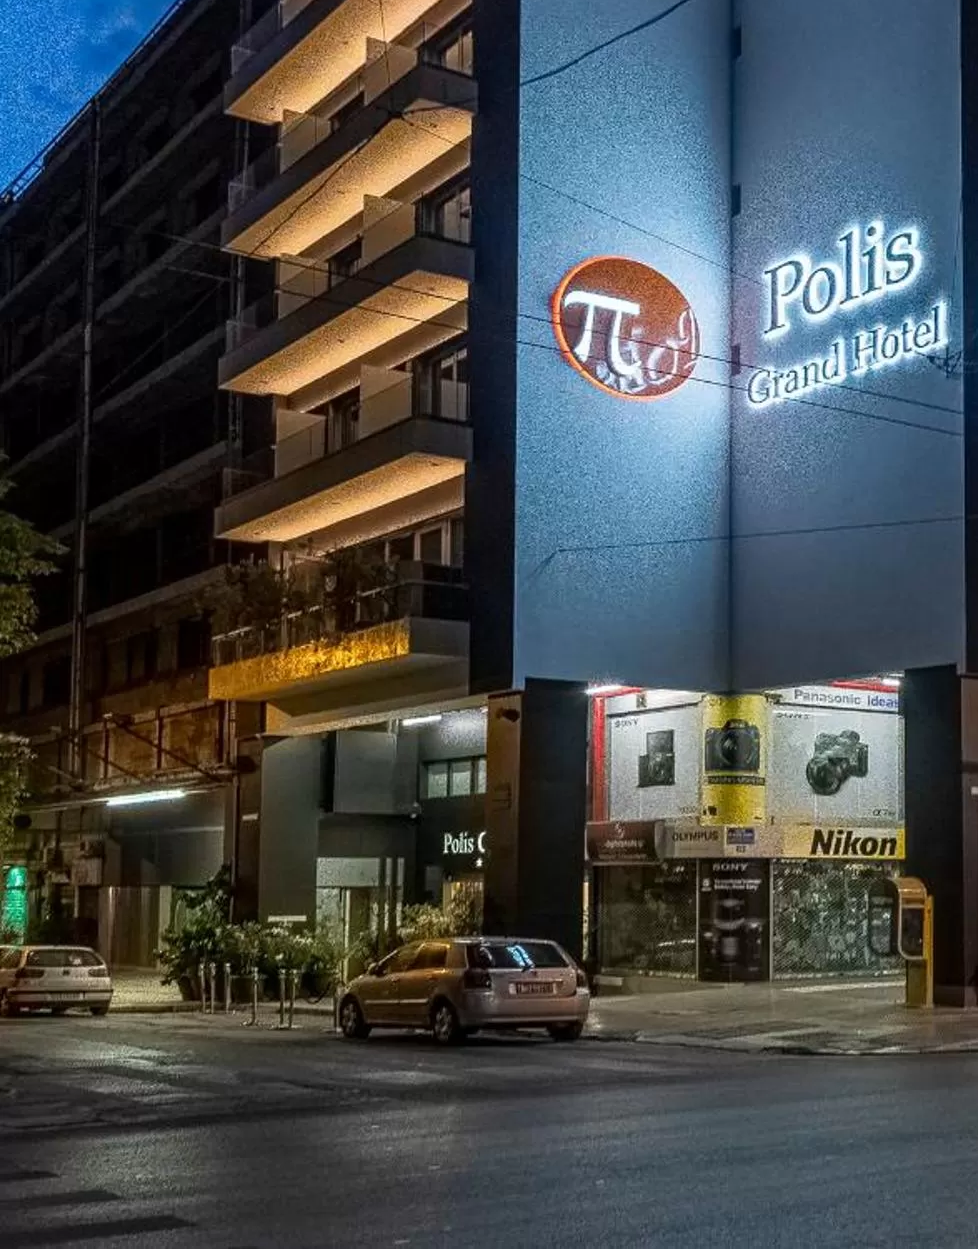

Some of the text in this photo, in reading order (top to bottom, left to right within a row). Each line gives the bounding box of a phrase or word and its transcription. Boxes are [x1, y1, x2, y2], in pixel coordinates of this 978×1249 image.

[763, 225, 919, 335] Polis
[748, 305, 945, 405] Grand Hotel
[794, 689, 861, 705] Panasonic
[442, 831, 474, 854] Polis
[672, 830, 719, 842] OLYMPUS
[810, 828, 897, 856] Nikon
[712, 862, 749, 872] SONY
